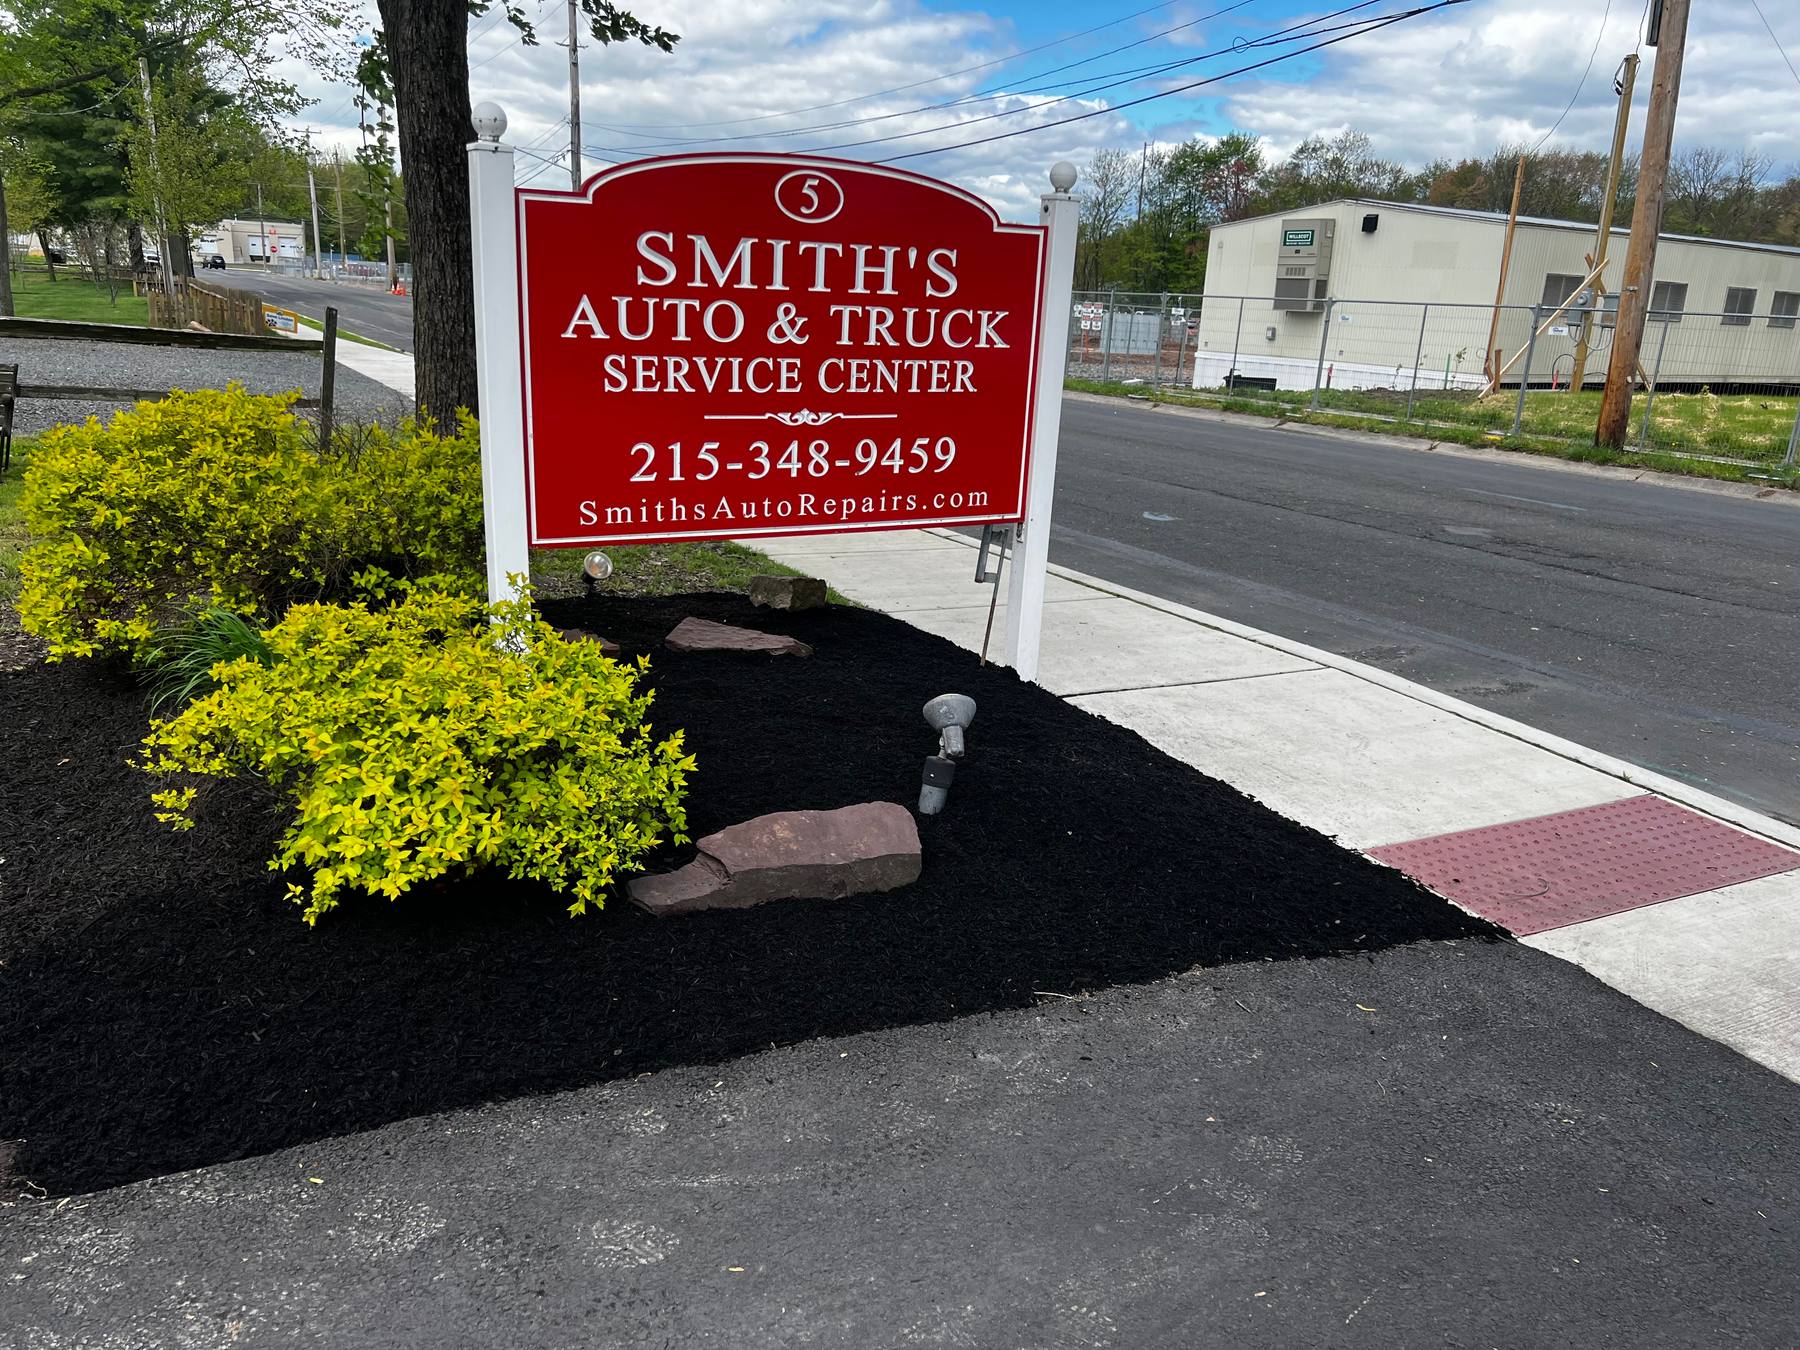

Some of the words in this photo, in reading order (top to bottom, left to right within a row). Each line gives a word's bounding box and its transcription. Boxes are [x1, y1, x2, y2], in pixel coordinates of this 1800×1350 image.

[799, 179, 819, 213] 5
[637, 232, 957, 297] SMITH'S
[561, 294, 744, 342] AUTO
[766, 303, 809, 345] &
[829, 304, 1011, 348] TRUCK
[604, 355, 802, 393] SERVICE
[817, 357, 978, 393] CENTER
[630, 437, 956, 482] 215-348-9459
[579, 489, 989, 527] SmithsAutoRepairs.com
